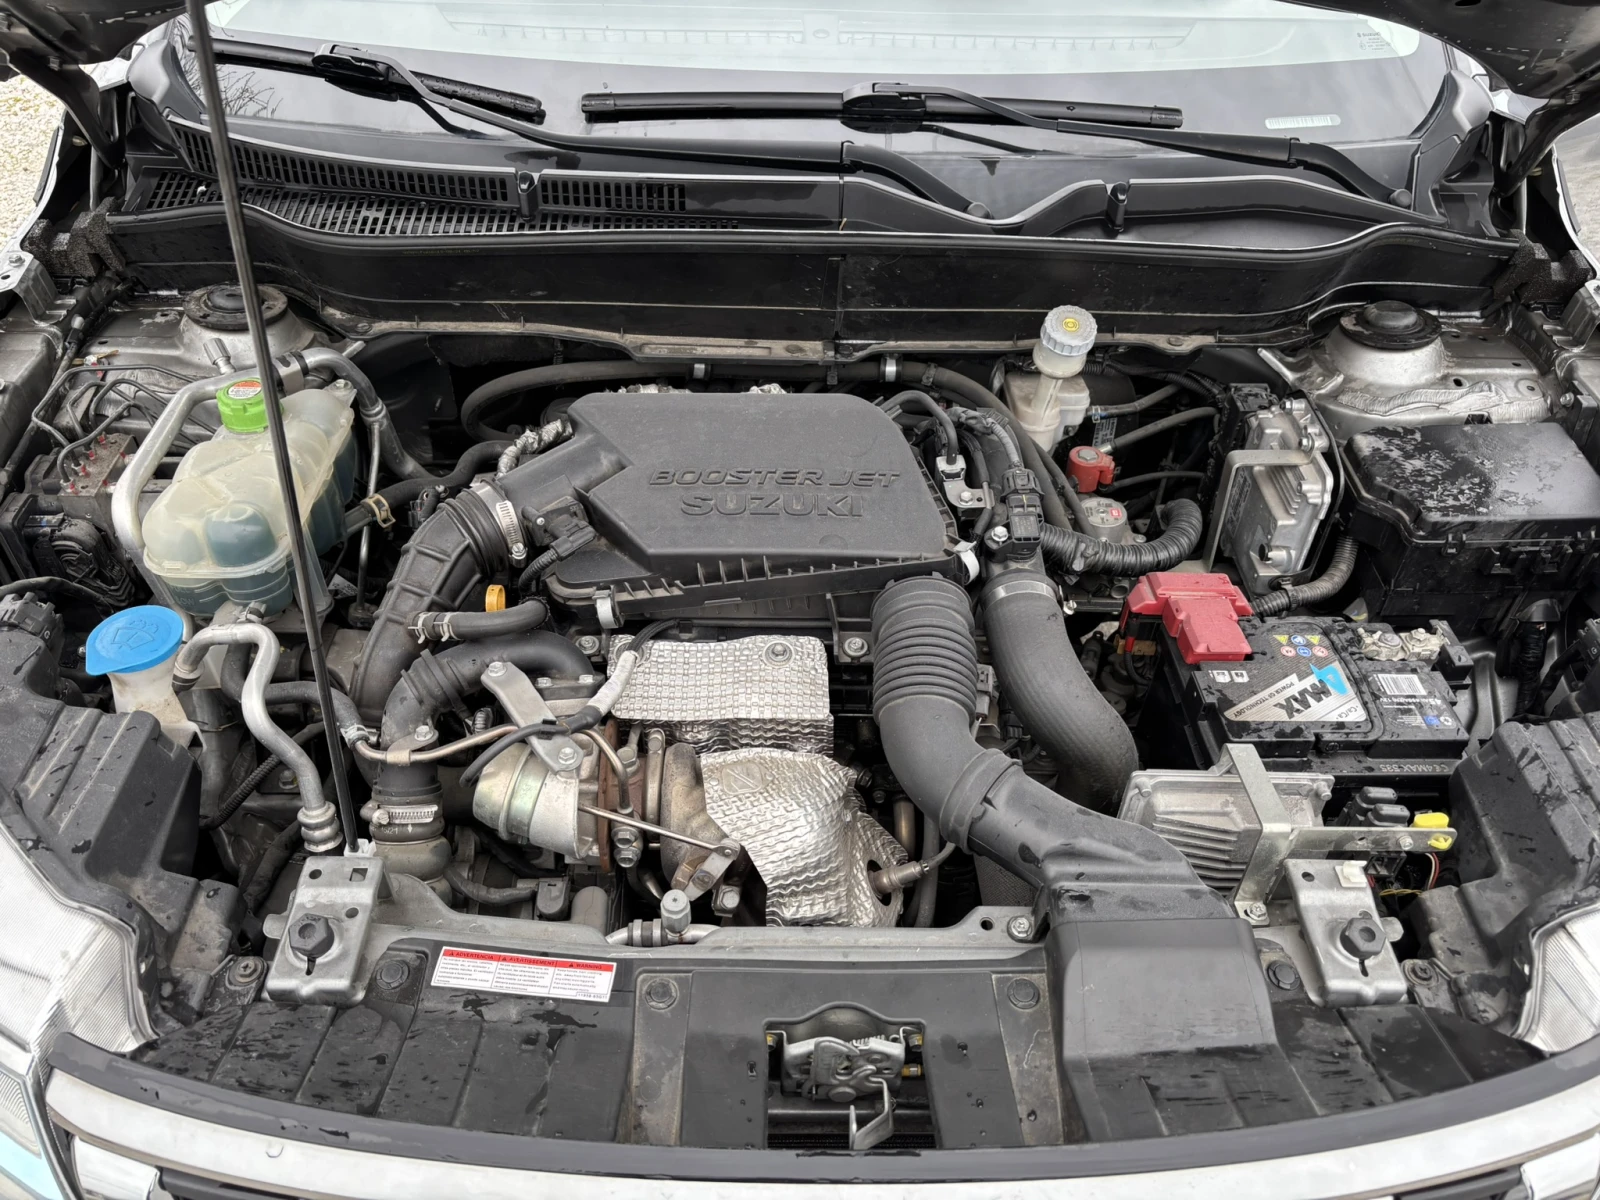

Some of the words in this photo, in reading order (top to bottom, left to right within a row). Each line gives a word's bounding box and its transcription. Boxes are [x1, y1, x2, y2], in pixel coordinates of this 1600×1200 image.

[681, 493, 864, 517] SUZUKI
[1273, 663, 1349, 720] 4MAX
[1276, 682, 1295, 695] POWER
[1233, 696, 1269, 718] TECHNOLOGY
[455, 951, 494, 961] ADVERTENCIA
[509, 956, 556, 966] AVERTISSEMENT
